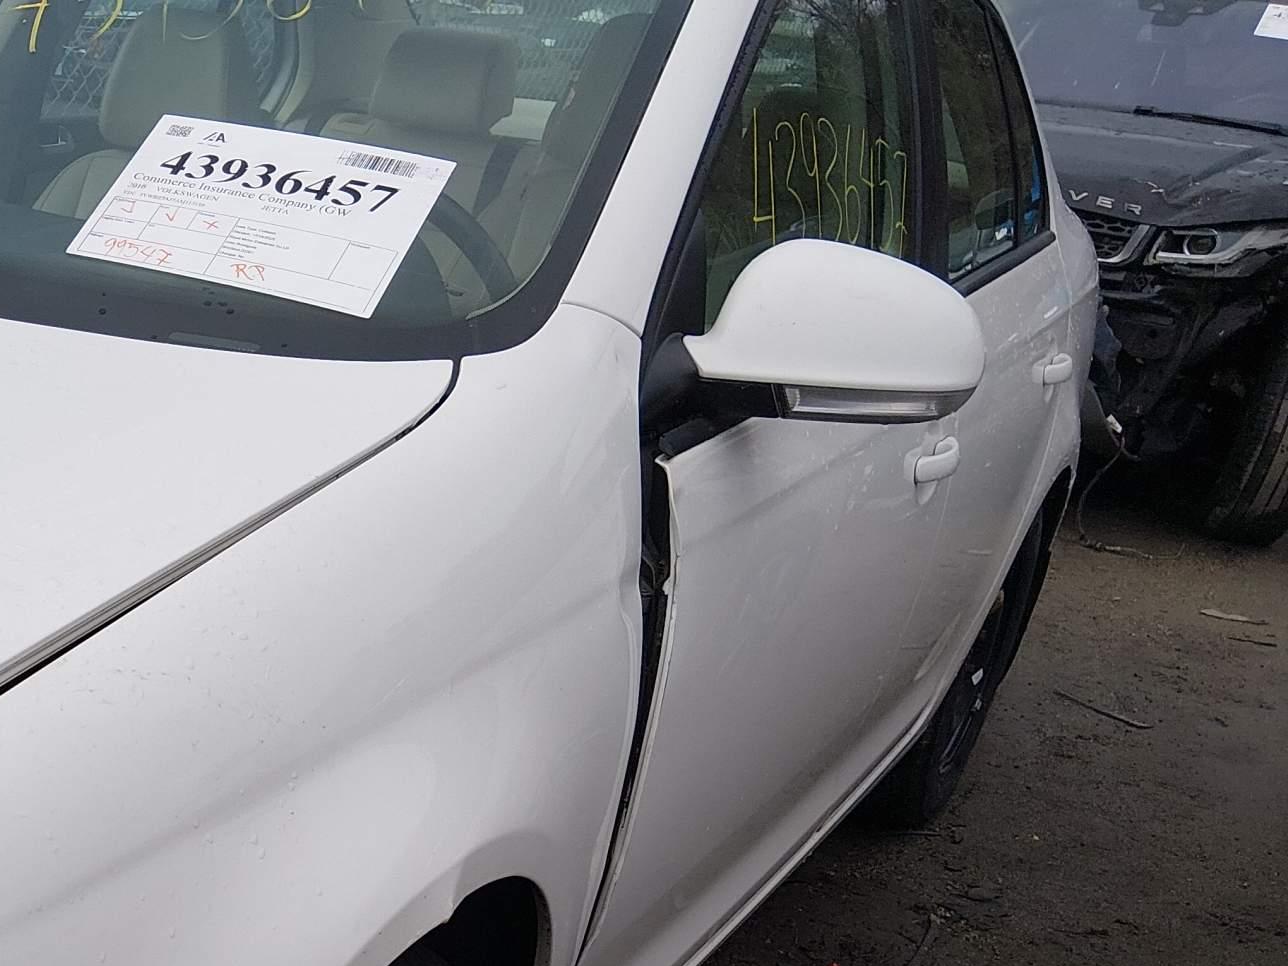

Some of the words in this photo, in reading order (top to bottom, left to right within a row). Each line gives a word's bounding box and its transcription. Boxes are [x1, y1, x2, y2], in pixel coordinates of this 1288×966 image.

[133, 172, 196, 188] Commerce
[198, 182, 256, 199] Insurance
[258, 192, 316, 211] Company
[318, 204, 353, 217] (GW
[159, 151, 401, 213] 43936457
